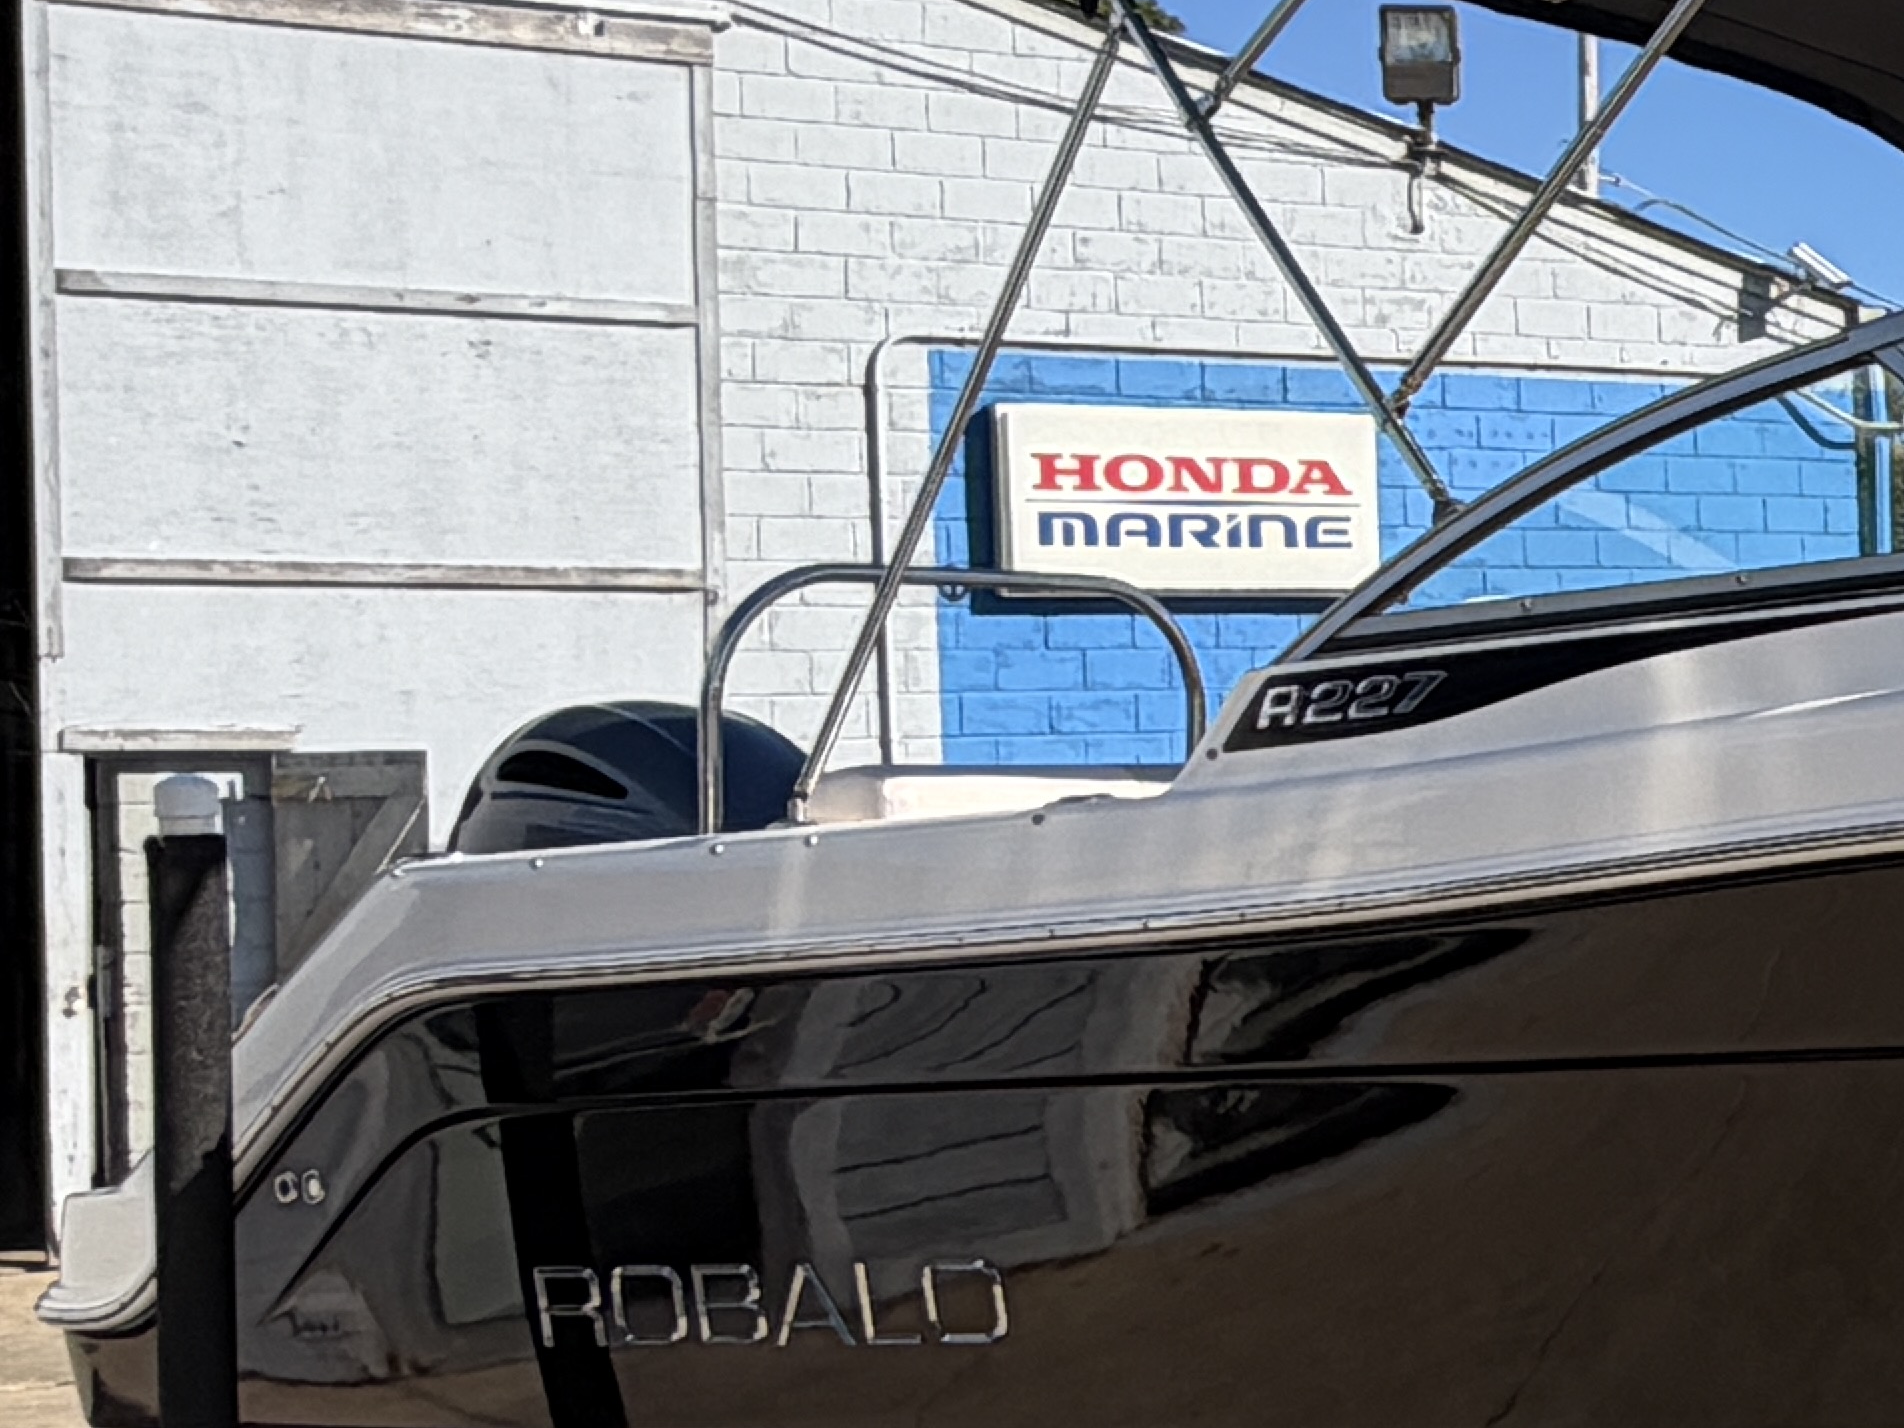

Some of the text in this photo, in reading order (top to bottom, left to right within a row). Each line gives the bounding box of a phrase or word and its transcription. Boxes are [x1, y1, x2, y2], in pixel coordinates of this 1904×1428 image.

[1030, 452, 1353, 495] HONDA
[1256, 670, 1448, 729] R227
[532, 1258, 1010, 1348] ROBALO
